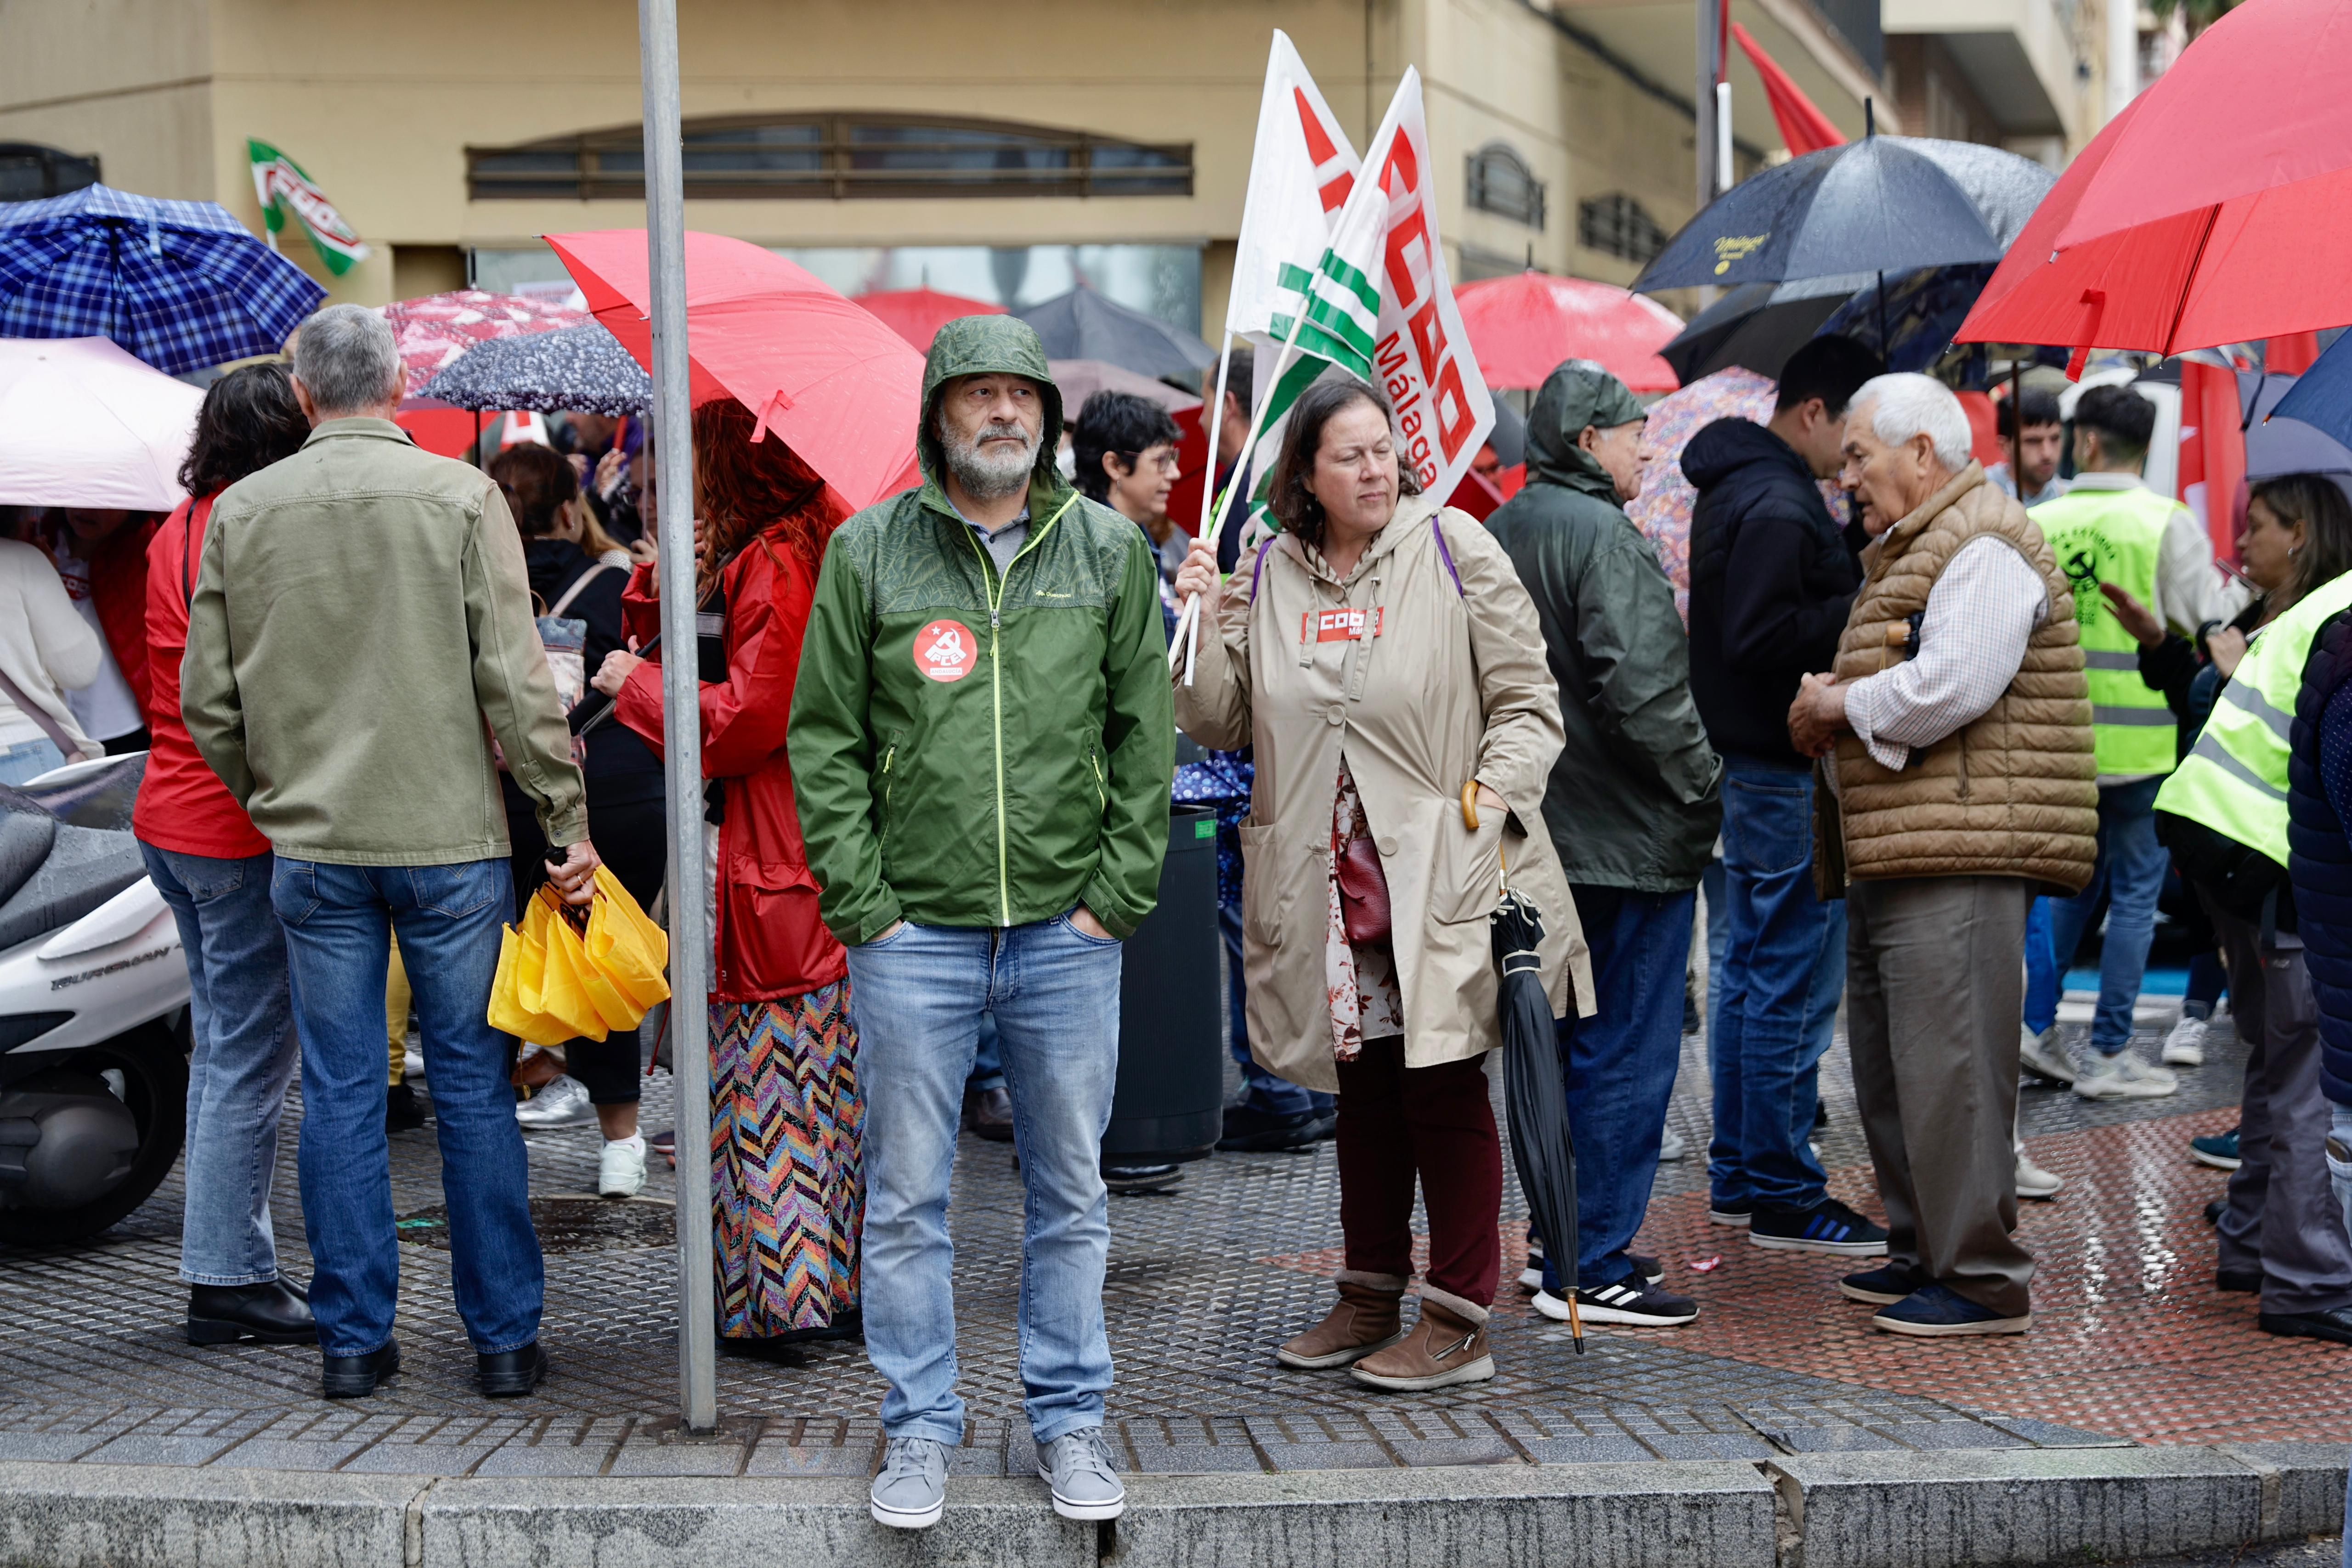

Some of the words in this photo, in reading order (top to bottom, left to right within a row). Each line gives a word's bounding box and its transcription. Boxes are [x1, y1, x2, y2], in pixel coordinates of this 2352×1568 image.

[1375, 330, 1437, 490] Málaga
[1306, 612, 1365, 631] COO
[929, 652, 962, 666] PCE
